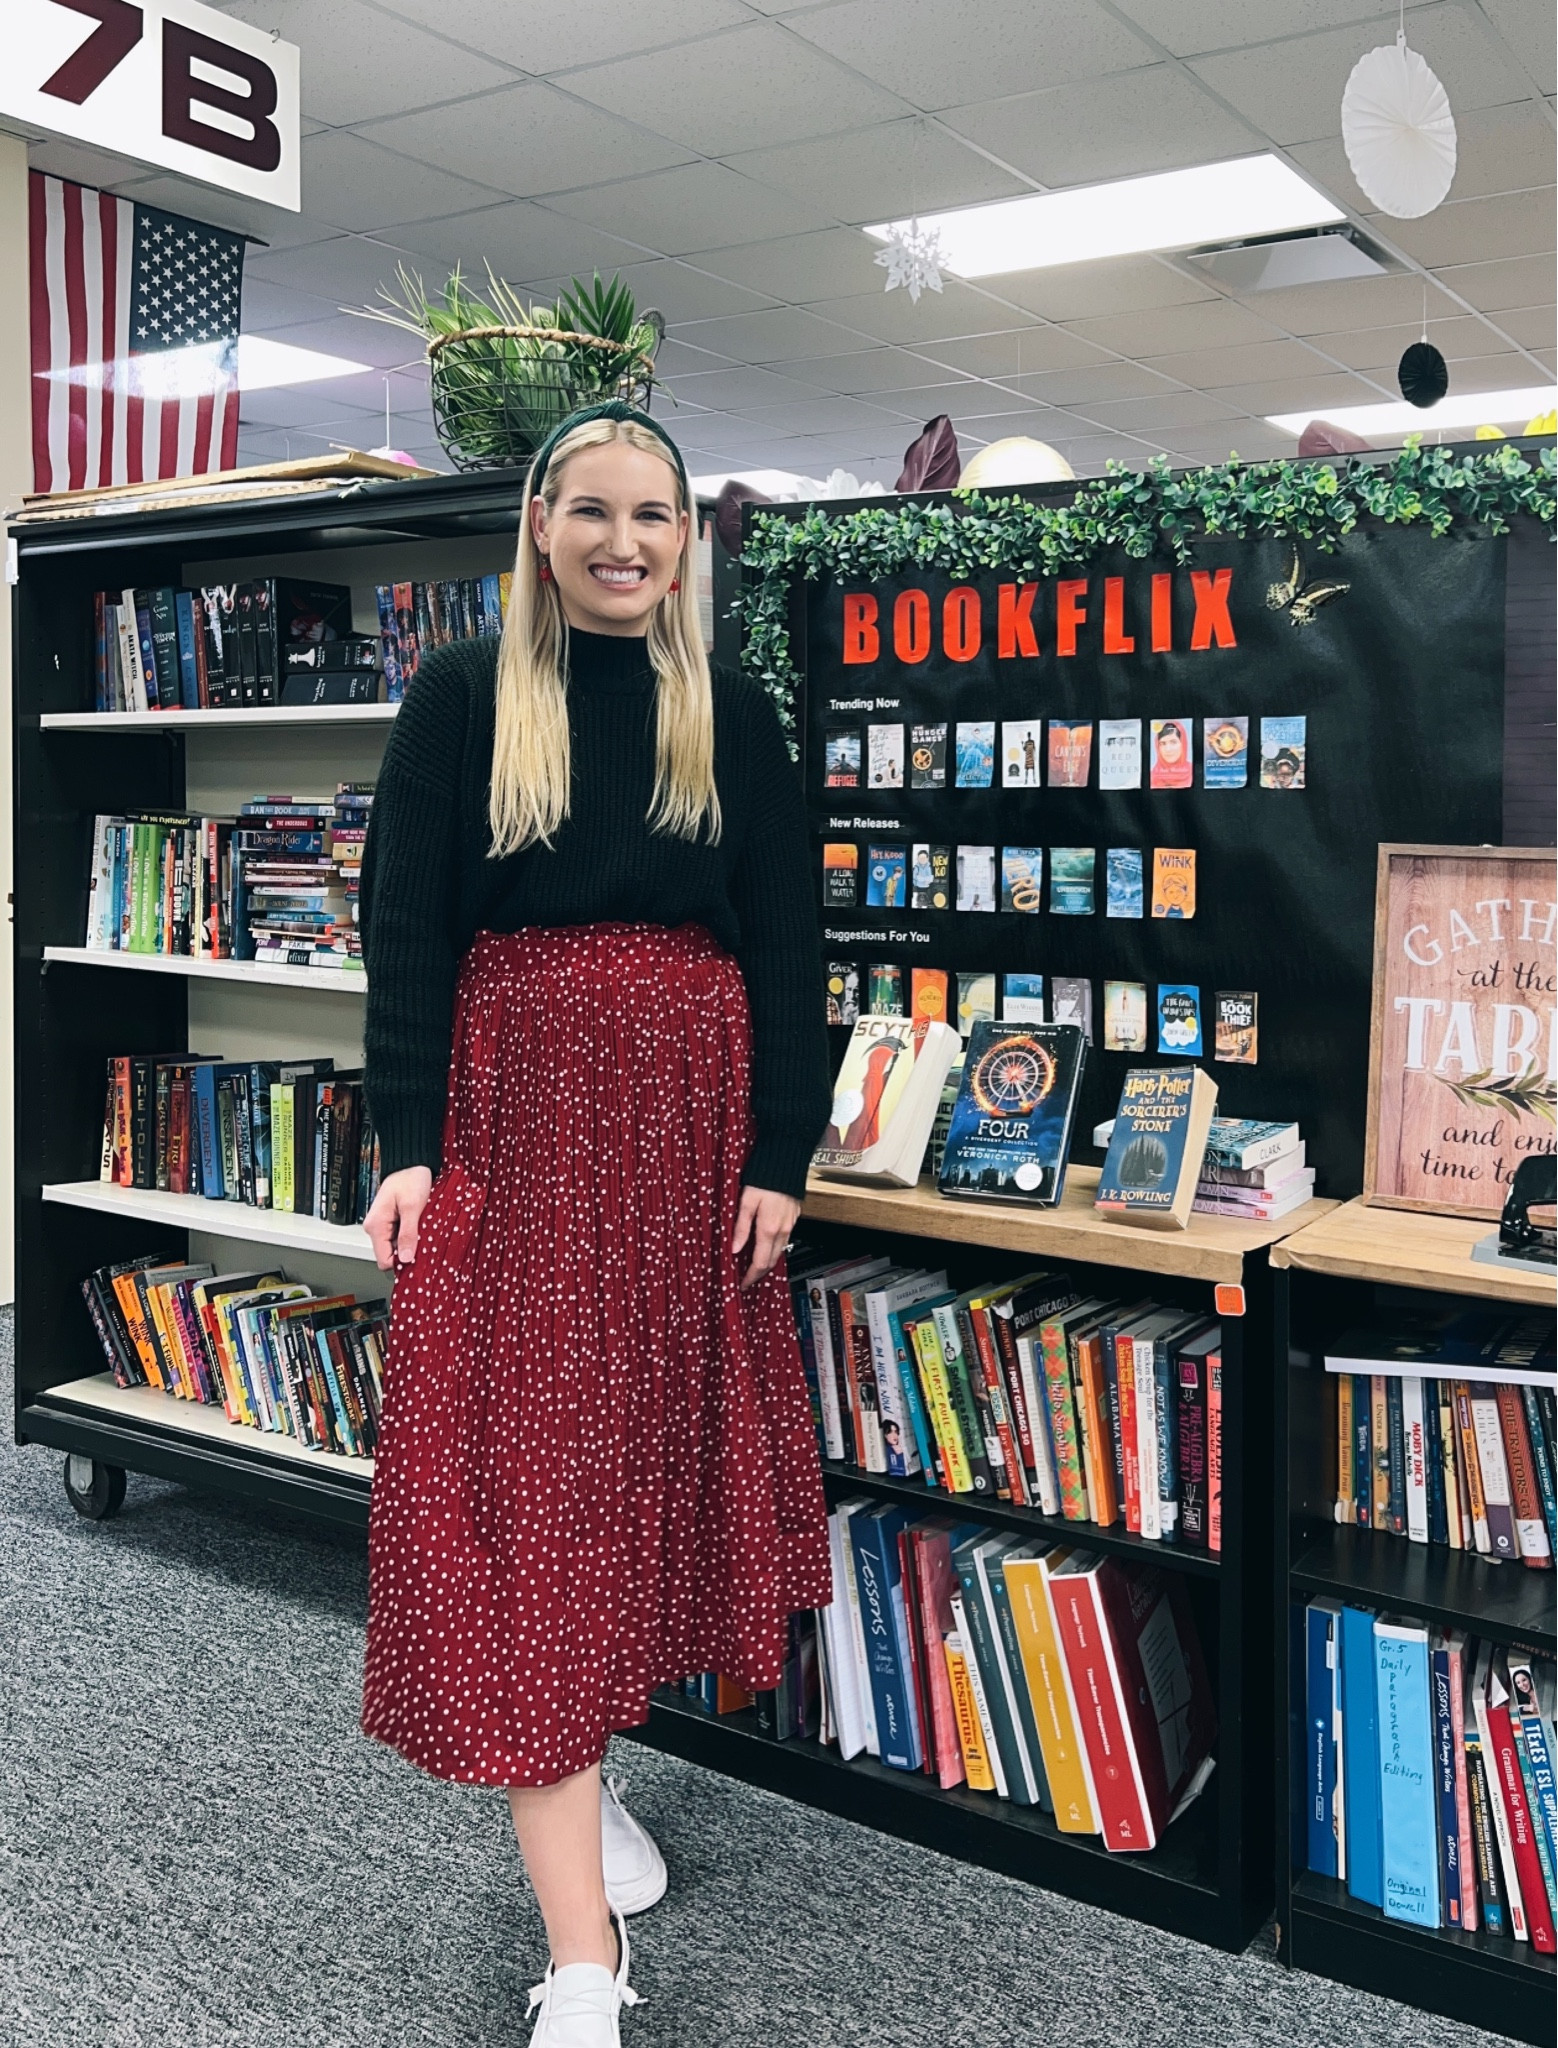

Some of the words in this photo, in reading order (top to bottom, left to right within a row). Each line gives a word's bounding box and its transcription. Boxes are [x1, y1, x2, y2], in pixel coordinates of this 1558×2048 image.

[38, 0, 281, 172] 7B
[843, 568, 1237, 665] BOOKFLIX
[830, 699, 874, 711] Trending
[876, 698, 900, 708] Now
[830, 818, 850, 828] New
[854, 818, 900, 828] Releases
[253, 832, 280, 845] Dragon
[281, 833, 302, 846] Rider
[1159, 854, 1192, 869] WINK
[288, 941, 306, 949] FAKE
[825, 928, 886, 942] Suggestions
[889, 930, 906, 941] For
[910, 932, 930, 942] You
[288, 951, 308, 964] elixir
[1457, 960, 1504, 988] at
[1514, 962, 1557, 992] the
[872, 1004, 902, 1016] MAZE
[1221, 1002, 1252, 1015] BOOK
[1222, 1014, 1252, 1026] THIEF
[855, 1022, 928, 1038] SCYTHE
[136, 1069, 147, 1111] THE
[1125, 1078, 1157, 1098] Harry
[1158, 1074, 1192, 1100] Potter
[1161, 1096, 1175, 1104] THE
[1121, 1104, 1187, 1118] SORCERER'S
[201, 1098, 213, 1178] DIVERGENT
[978, 1119, 1029, 1139] FOUR
[1132, 1120, 1172, 1132] STONE
[1443, 1120, 1504, 1148] and
[137, 1118, 147, 1174] TOLL
[223, 1109, 234, 1184] INSURGENT
[957, 1150, 1007, 1161] VERONICA
[1013, 1155, 1040, 1164] ROTH
[1260, 1142, 1281, 1160] CLARK
[1421, 1150, 1483, 1181] time
[1120, 1190, 1172, 1202] ROWLING
[1014, 1312, 1034, 1330] PORT
[1034, 1296, 1069, 1321] CHICAGO
[128, 1317, 143, 1344] WINK
[138, 1319, 153, 1347] WINK
[184, 1320, 203, 1359] SPIN
[872, 1333, 883, 1342] I
[875, 1344, 884, 1359] AM
[1133, 1347, 1144, 1377] Teenage
[877, 1361, 888, 1388] HERE
[936, 1310, 951, 1340] FOWLER
[949, 1365, 967, 1406] SNAKES
[960, 1413, 977, 1453] STONES
[1008, 1370, 1020, 1394] PORT
[1137, 1378, 1145, 1394] Soul
[1145, 1377, 1153, 1395] Soup
[336, 1363, 357, 1421] FIRESTORM!
[881, 1389, 892, 1416] NOW
[1050, 1379, 1065, 1413] Hello,
[1146, 1397, 1154, 1410] for
[1156, 1385, 1165, 1408] NOT
[930, 1366, 945, 1399] FIRST
[938, 1401, 952, 1428] RULE
[946, 1435, 962, 1468] PUNK
[1012, 1394, 1029, 1433] CHICAGO
[1157, 1409, 1165, 1422] AS
[1503, 1400, 1517, 1426] THE
[1020, 1432, 1031, 1446] 50
[1054, 1412, 1070, 1466] Sunshine
[1108, 1382, 1120, 1439] ALABAMA
[1114, 1442, 1125, 1476] MOON
[1158, 1424, 1166, 1445] WE
[1180, 1411, 1190, 1473] ALGEBRA
[1207, 1407, 1216, 1457] LANGUAGE
[1412, 1421, 1422, 1457] MOBY
[1191, 1405, 1202, 1483] PRE-ALGEBRA
[1158, 1448, 1168, 1485] KNOW
[1209, 1458, 1217, 1479] ARTS
[1414, 1459, 1424, 1487] DICK
[1508, 1429, 1529, 1497] TRAITORS'
[1540, 1468, 1549, 1478] TO
[1160, 1485, 1168, 1499] IT
[857, 1545, 894, 1638] Lessons
[1379, 1640, 1396, 1652] Gr.
[1398, 1644, 1408, 1654] 5
[1038, 1652, 1052, 1691] Time-Saver
[1380, 1658, 1412, 1676] Daily
[949, 1657, 978, 1746] Thesaurus
[967, 1662, 981, 1688] THIS
[974, 1690, 988, 1718] SAME
[981, 1721, 995, 1744] SKY
[1433, 1670, 1454, 1719] Lessons
[1085, 1667, 1100, 1706] Time-Saver
[1095, 1705, 1112, 1756] Transparencies
[1439, 1740, 1452, 1766] Change
[1524, 1724, 1546, 1765] TExES
[1536, 1768, 1553, 1791] ESL
[1384, 1763, 1424, 1785] Editing
[1443, 1767, 1453, 1793] Writers
[1475, 1759, 1487, 1800] NAVIGATING
[1500, 1747, 1519, 1791] Grammar
[1523, 1772, 1532, 1786] THE
[1509, 1792, 1523, 1808] for
[1512, 1808, 1530, 1844] Writing
[1526, 1788, 1543, 1840] UNSTOPPABLE
[1470, 1774, 1480, 1804] COMMON
[1478, 1843, 1490, 1882] STANDARDS
[1481, 1815, 1491, 1842] ENGLISH
[1484, 1842, 1495, 1878] LANGUAGE
[1537, 1842, 1551, 1876] WRITING
[1489, 1878, 1498, 1897] ARTS
[1544, 1878, 1557, 1913] TEACHER
